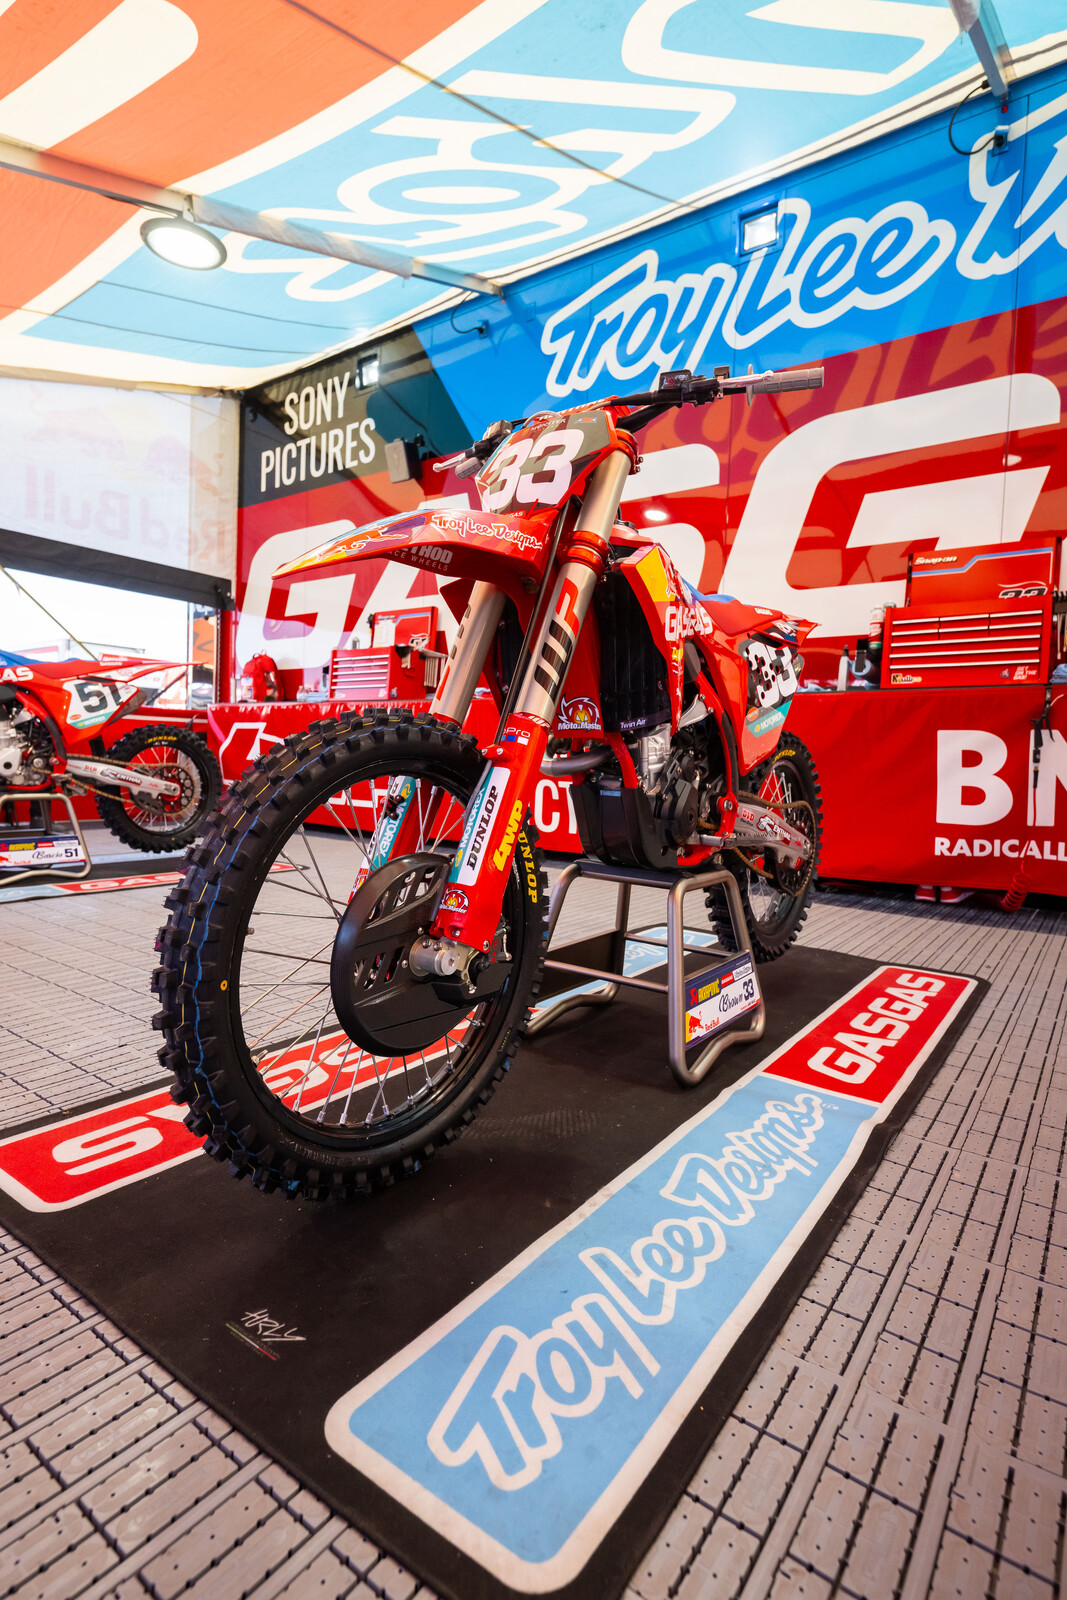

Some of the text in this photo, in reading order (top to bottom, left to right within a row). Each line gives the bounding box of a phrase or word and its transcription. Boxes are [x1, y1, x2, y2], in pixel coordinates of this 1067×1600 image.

[541, 198, 957, 397] Troy Lee
[284, 371, 351, 435] SONY
[260, 417, 376, 493] PICTURES
[482, 428, 585, 512] 33
[432, 515, 543, 550] Troy Lee Designs
[411, 555, 449, 572] WHEELS
[914, 556, 958, 566] Snap-on
[75, 681, 123, 713] 51
[620, 717, 647, 729] Twin Air
[466, 785, 499, 871] DUNLOP
[64, 848, 79, 858] 51
[719, 993, 743, 1013] Brown
[742, 978, 754, 1002] 33
[807, 973, 946, 1084] GASGAS
[428, 1293, 660, 1492] Troy
[579, 1217, 726, 1325] Lee
[660, 1092, 826, 1226] Designs
